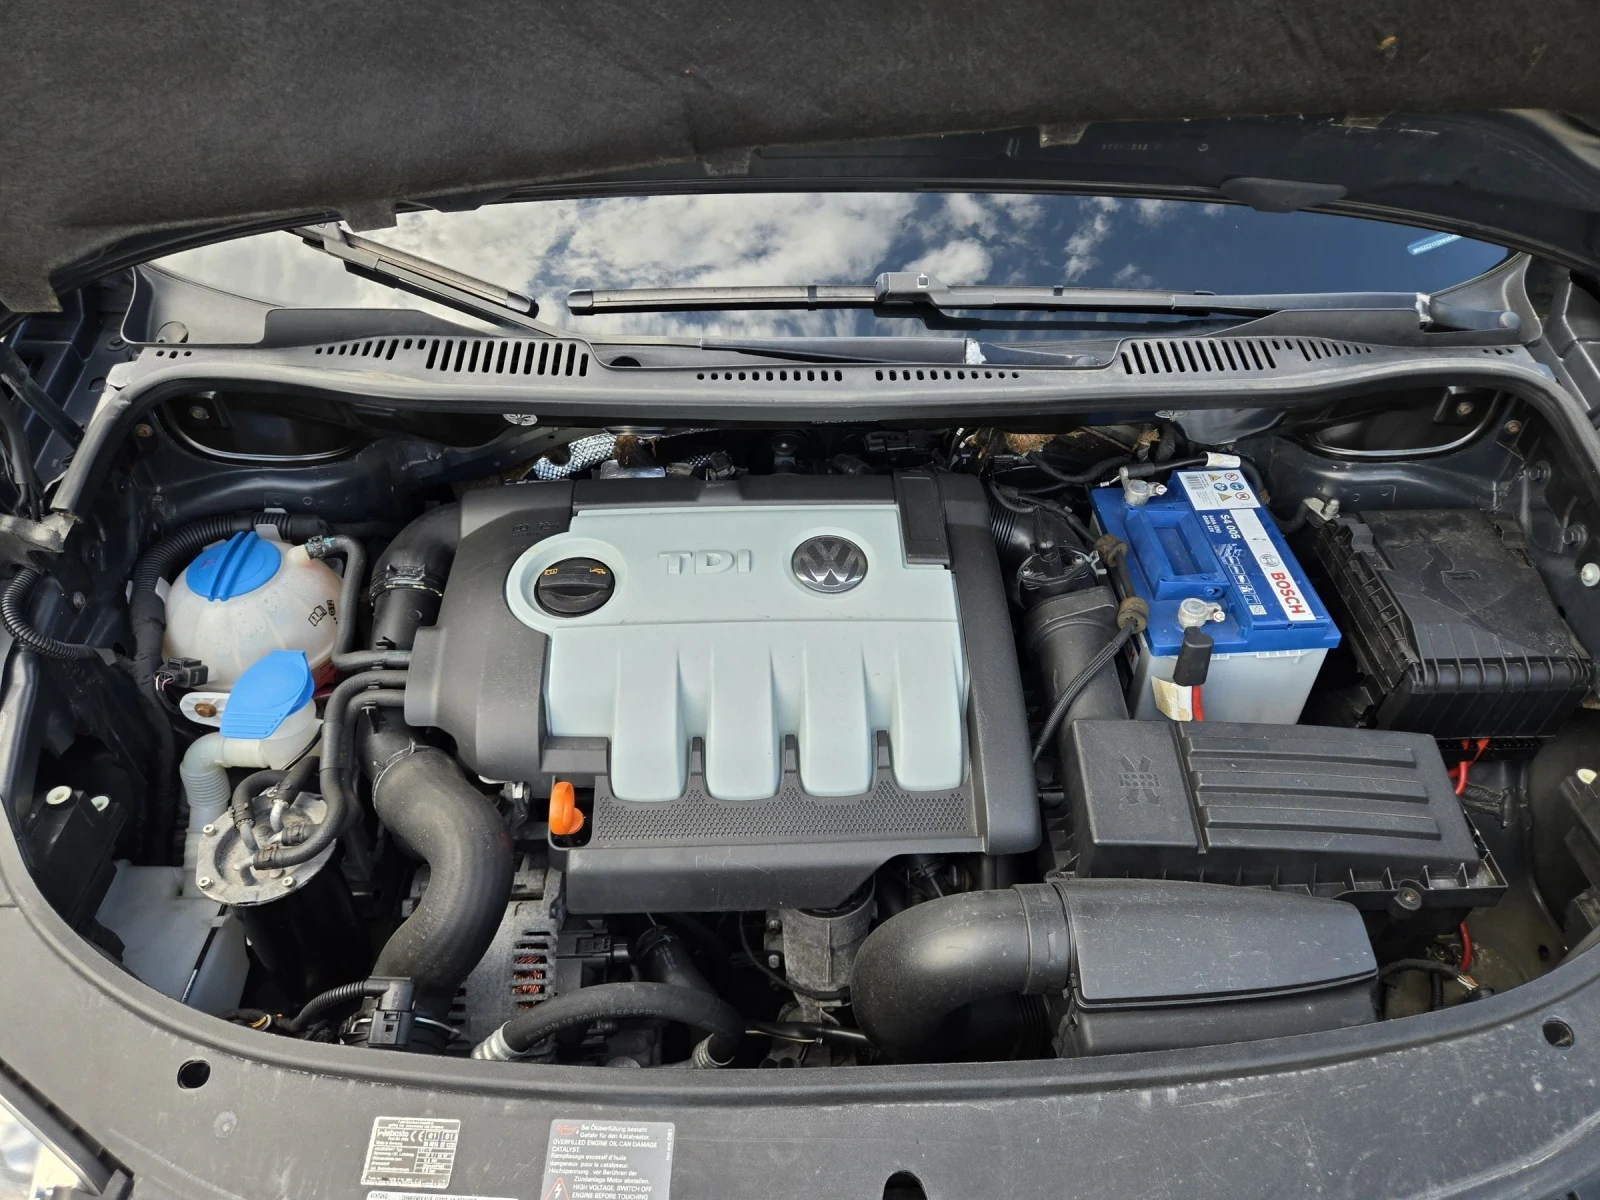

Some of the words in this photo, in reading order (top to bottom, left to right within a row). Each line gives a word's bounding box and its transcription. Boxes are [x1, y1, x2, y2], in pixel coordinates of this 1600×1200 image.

[1220, 514, 1232, 526] S4
[1226, 525, 1241, 540] 005
[658, 549, 752, 575] TDI
[1270, 572, 1307, 614] BOSCH
[591, 1124, 626, 1132] Ölüberfüllung
